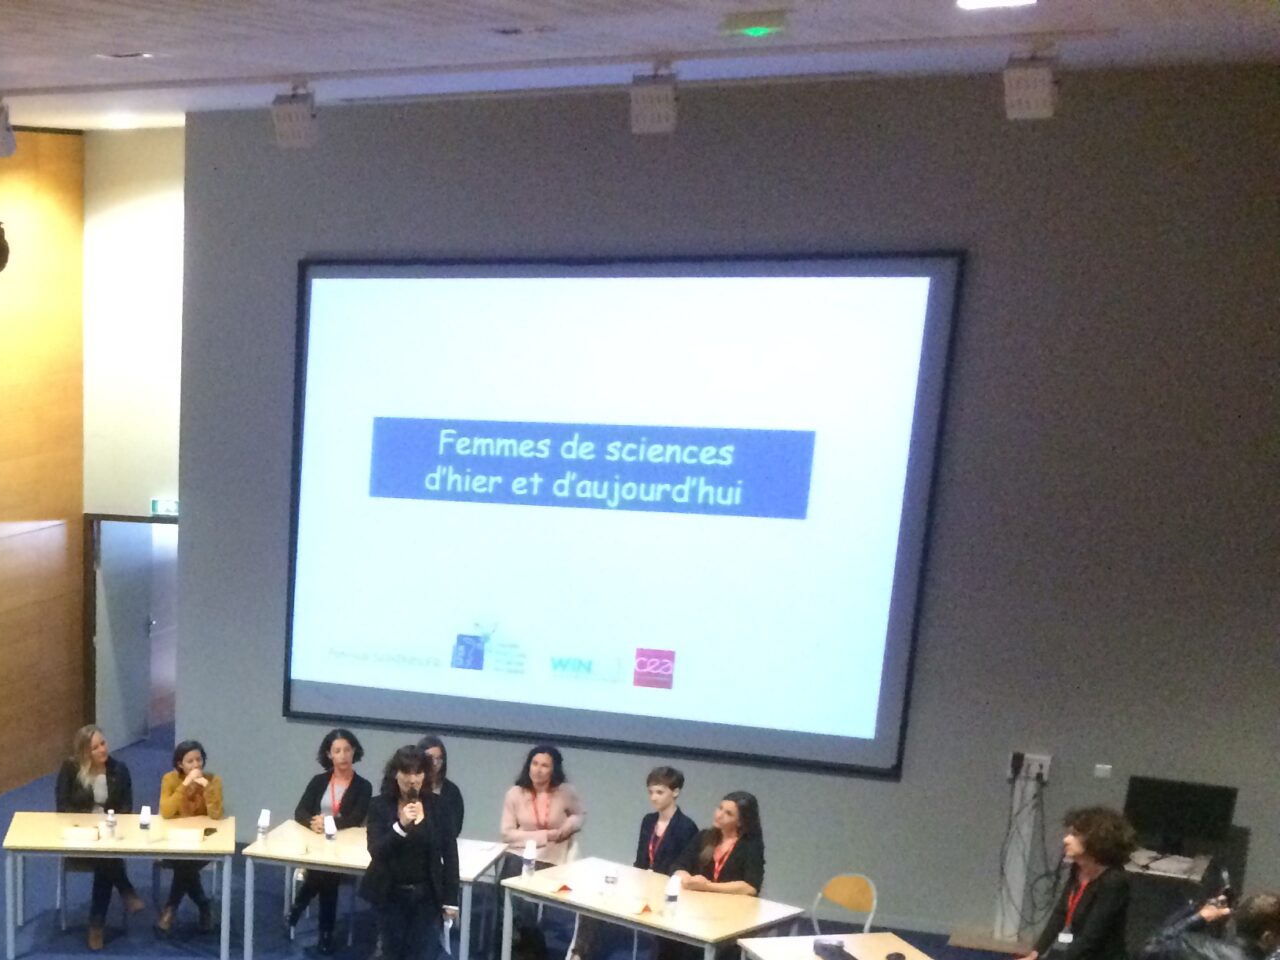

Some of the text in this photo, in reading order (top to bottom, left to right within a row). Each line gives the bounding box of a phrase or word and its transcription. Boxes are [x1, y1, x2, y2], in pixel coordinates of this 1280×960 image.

[438, 428, 735, 466] Femmes de sciences
[424, 465, 743, 508] d'hier et d'aujourd'hui
